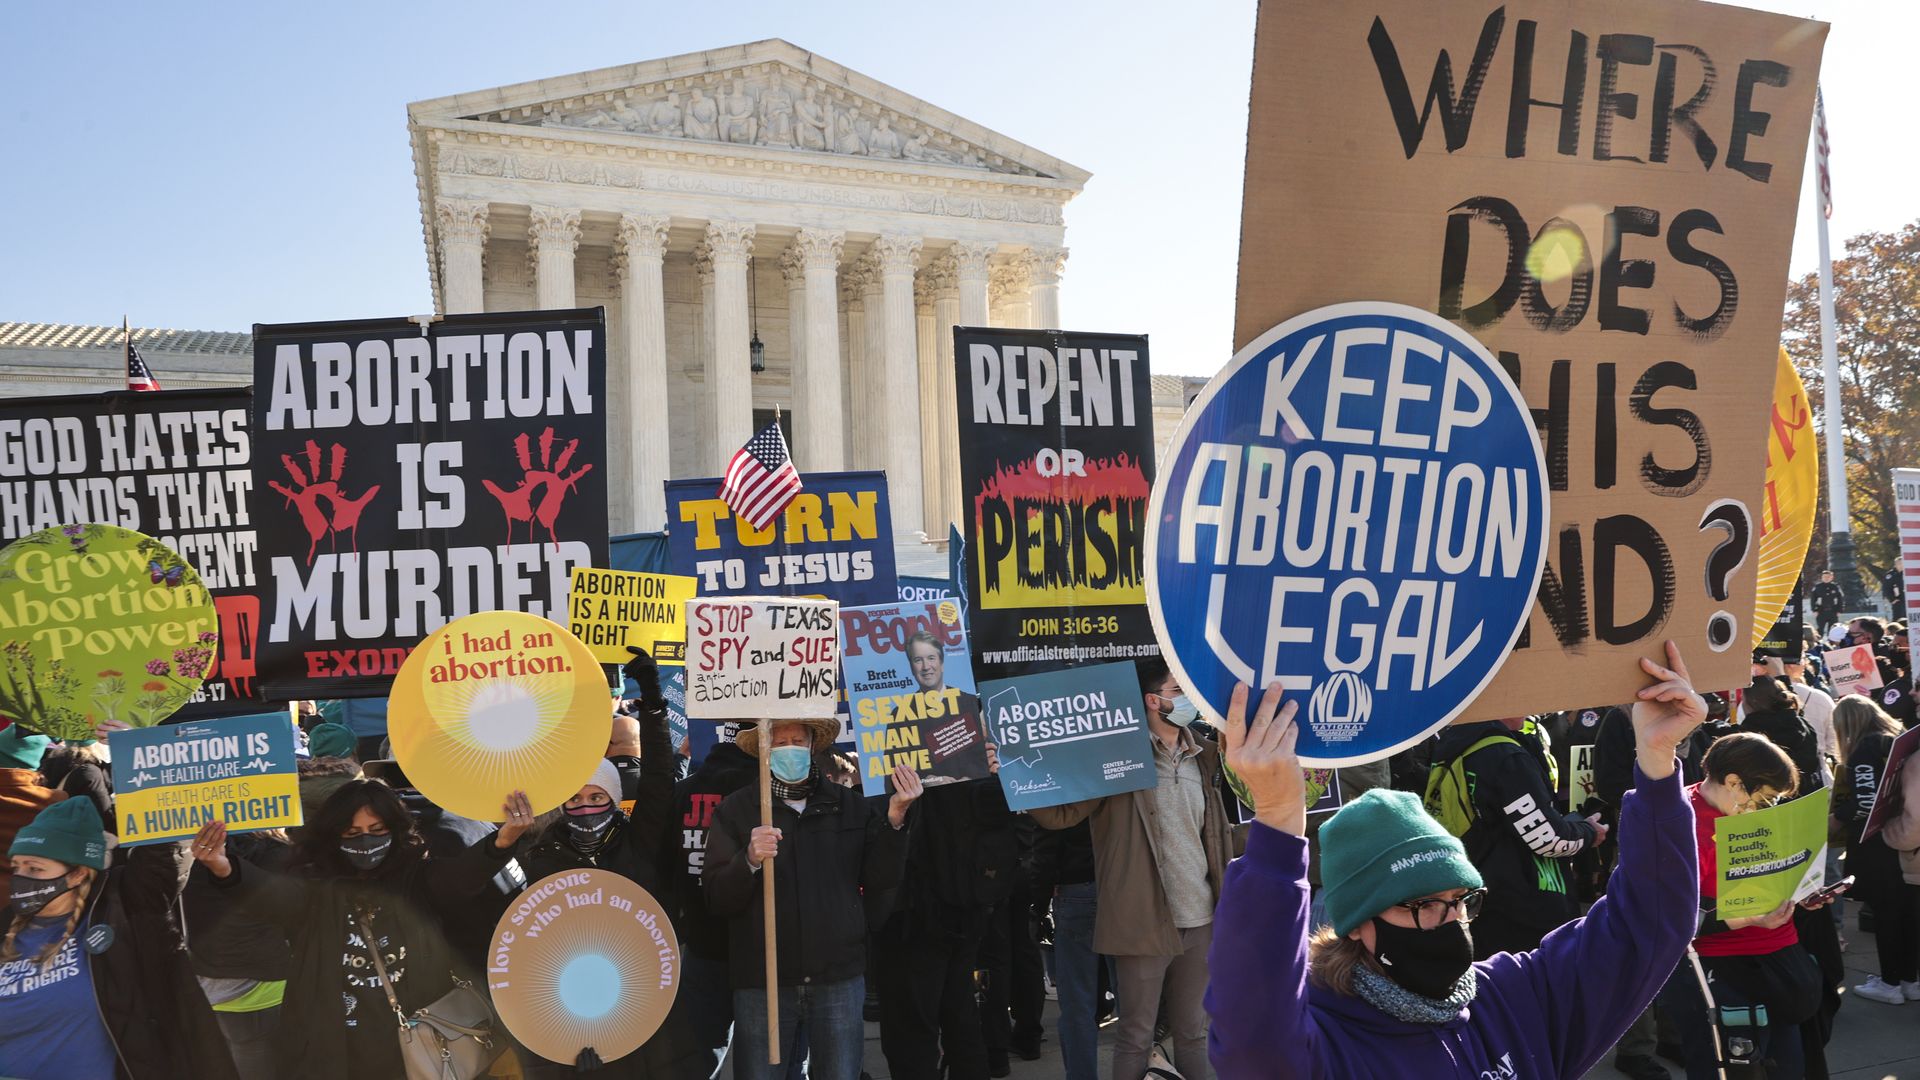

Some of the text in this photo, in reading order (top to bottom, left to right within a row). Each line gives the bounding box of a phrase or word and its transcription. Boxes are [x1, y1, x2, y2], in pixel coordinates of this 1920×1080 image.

[1367, 6, 1794, 184] WHERE
[1437, 196, 1738, 342] DOES
[266, 329, 594, 430] ABORTION
[968, 343, 1138, 427] REPENT
[1260, 328, 1491, 452] KEEP
[1498, 350, 1711, 497] HIS
[0, 409, 251, 477] GOD HATES
[1035, 448, 1087, 478] OR
[396, 441, 466, 529] IS
[1896, 483, 1916, 501] GOD
[1, 469, 253, 540] HANDS THAT
[1178, 442, 1527, 578] ABORTION
[981, 495, 1147, 595] PERISH
[15, 548, 154, 594] Grow
[573, 572, 666, 600] ABORTION
[696, 551, 875, 591] TO JESUS
[1514, 498, 1754, 655] ND?
[573, 597, 676, 624] IS A HUMAN
[695, 604, 833, 637] STOP TEXAS
[1019, 616, 1119, 637] JOHN 3:16-36
[33, 617, 209, 661] Power
[443, 629, 554, 655] i had an
[571, 623, 629, 646] RIGHT
[1204, 572, 1482, 692] LEGAL
[430, 651, 573, 684] abortion.
[699, 635, 835, 672] SPY and SUE
[983, 642, 1160, 664] www.officialstreetpreachers.com
[1830, 662, 1850, 672] RIGHT
[694, 675, 768, 702] abortion
[853, 677, 914, 693] Kavanaugh
[867, 668, 897, 681] Brett
[1834, 672, 1866, 685] DECISION
[857, 688, 962, 727] SEXIST
[998, 690, 1107, 726] ABORTION
[1309, 672, 1372, 722] NOW
[861, 725, 921, 754] MAN
[1000, 706, 1139, 746] IS ESSENTIAL
[133, 732, 271, 770] ABORTION IS
[868, 749, 933, 779] ALIVE
[1102, 760, 1124, 769] CENTER
[1103, 762, 1145, 774] REPRODUCTIVE
[160, 761, 241, 785] HEALTH CARE
[1104, 771, 1125, 780] RIGHTS
[1854, 764, 1876, 790] CRY
[156, 782, 250, 808] HEALTH CARE IS
[126, 794, 292, 836] A HUMAN RIGHT
[1728, 858, 1787, 877] PRO-ABORTION
[510, 871, 592, 927] someone
[489, 931, 516, 974] love
[525, 888, 676, 990] who had an abortion.
[22, 966, 80, 993] RIGHTS
[489, 980, 511, 990] i
